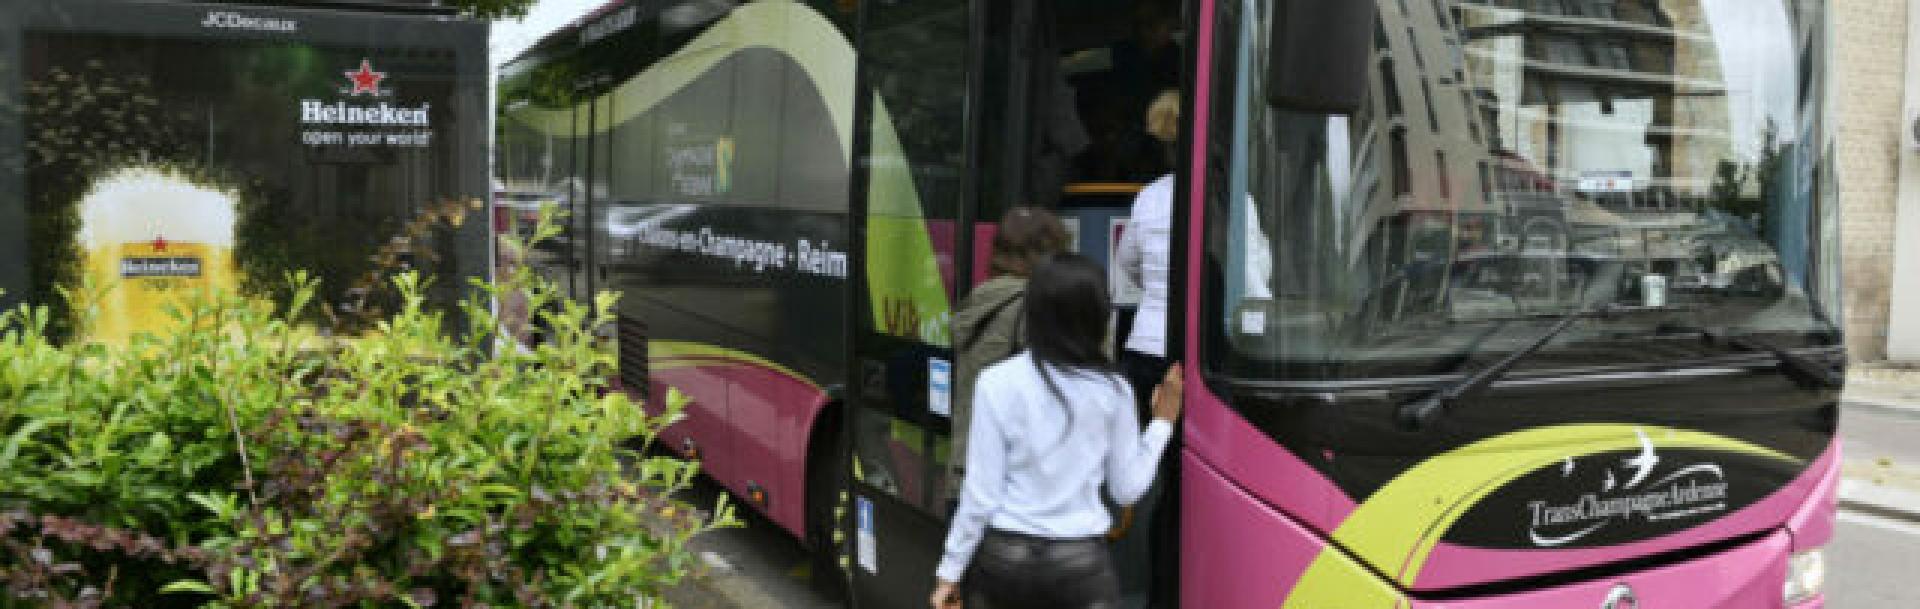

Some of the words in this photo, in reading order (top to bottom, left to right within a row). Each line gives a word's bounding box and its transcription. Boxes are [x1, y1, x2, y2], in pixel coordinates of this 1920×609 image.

[201, 11, 296, 31] JCDecaux
[301, 99, 429, 125] Heineken
[302, 131, 342, 147] open
[348, 132, 381, 148] your
[121, 258, 200, 274] Heineken
